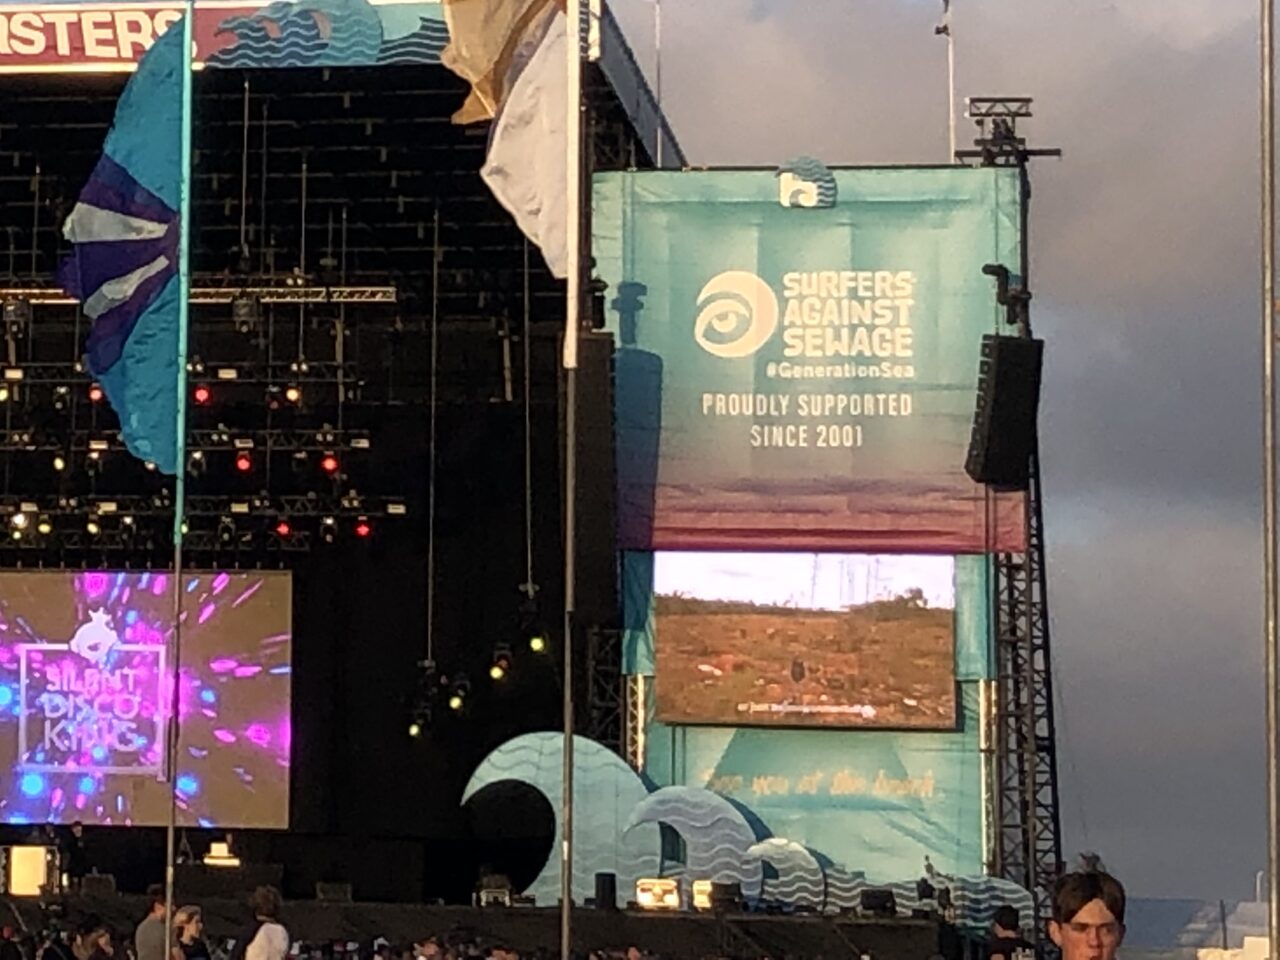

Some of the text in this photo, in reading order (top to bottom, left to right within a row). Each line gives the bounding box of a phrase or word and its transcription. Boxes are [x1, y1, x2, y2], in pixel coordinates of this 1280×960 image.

[783, 271, 914, 298] SURFERS
[783, 299, 914, 326] AGAINST
[783, 327, 913, 357] SEWAGE
[766, 362, 915, 378] #GenerationSea
[702, 393, 913, 416] PROUDLY SUPPORTED
[750, 425, 863, 448] SINCE 2001
[46, 666, 138, 693] SILENT
[44, 693, 139, 719] DISCO
